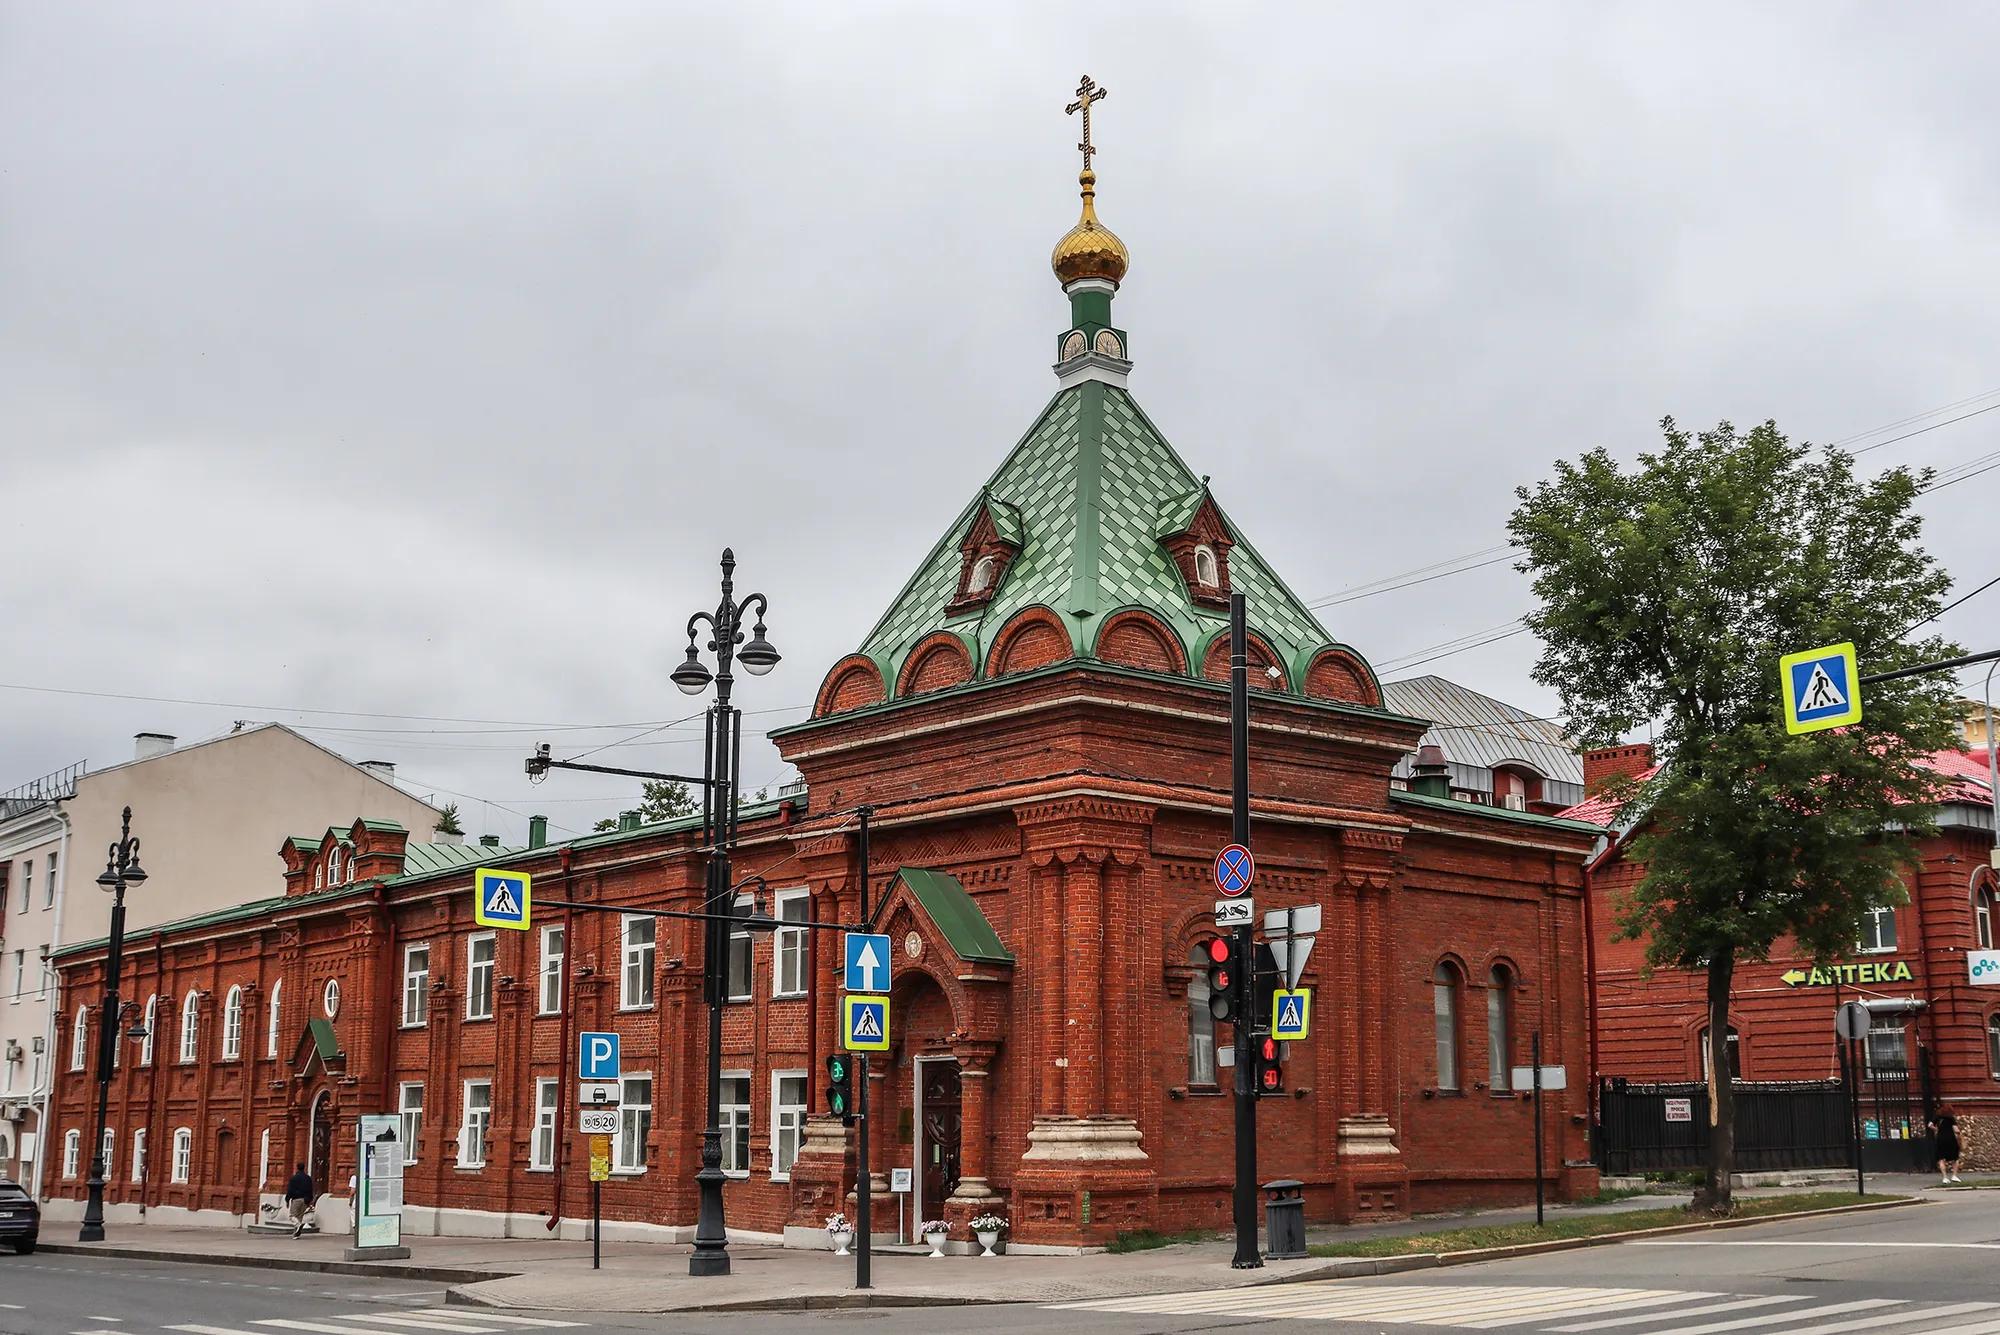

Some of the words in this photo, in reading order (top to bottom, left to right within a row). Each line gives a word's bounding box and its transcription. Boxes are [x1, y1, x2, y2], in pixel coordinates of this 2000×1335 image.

[1808, 961, 1913, 986] АПТЕКА
[591, 1037, 612, 1074] P
[584, 1118, 591, 1126] 10
[592, 1117, 600, 1127] 15
[602, 1116, 614, 1127] 20
